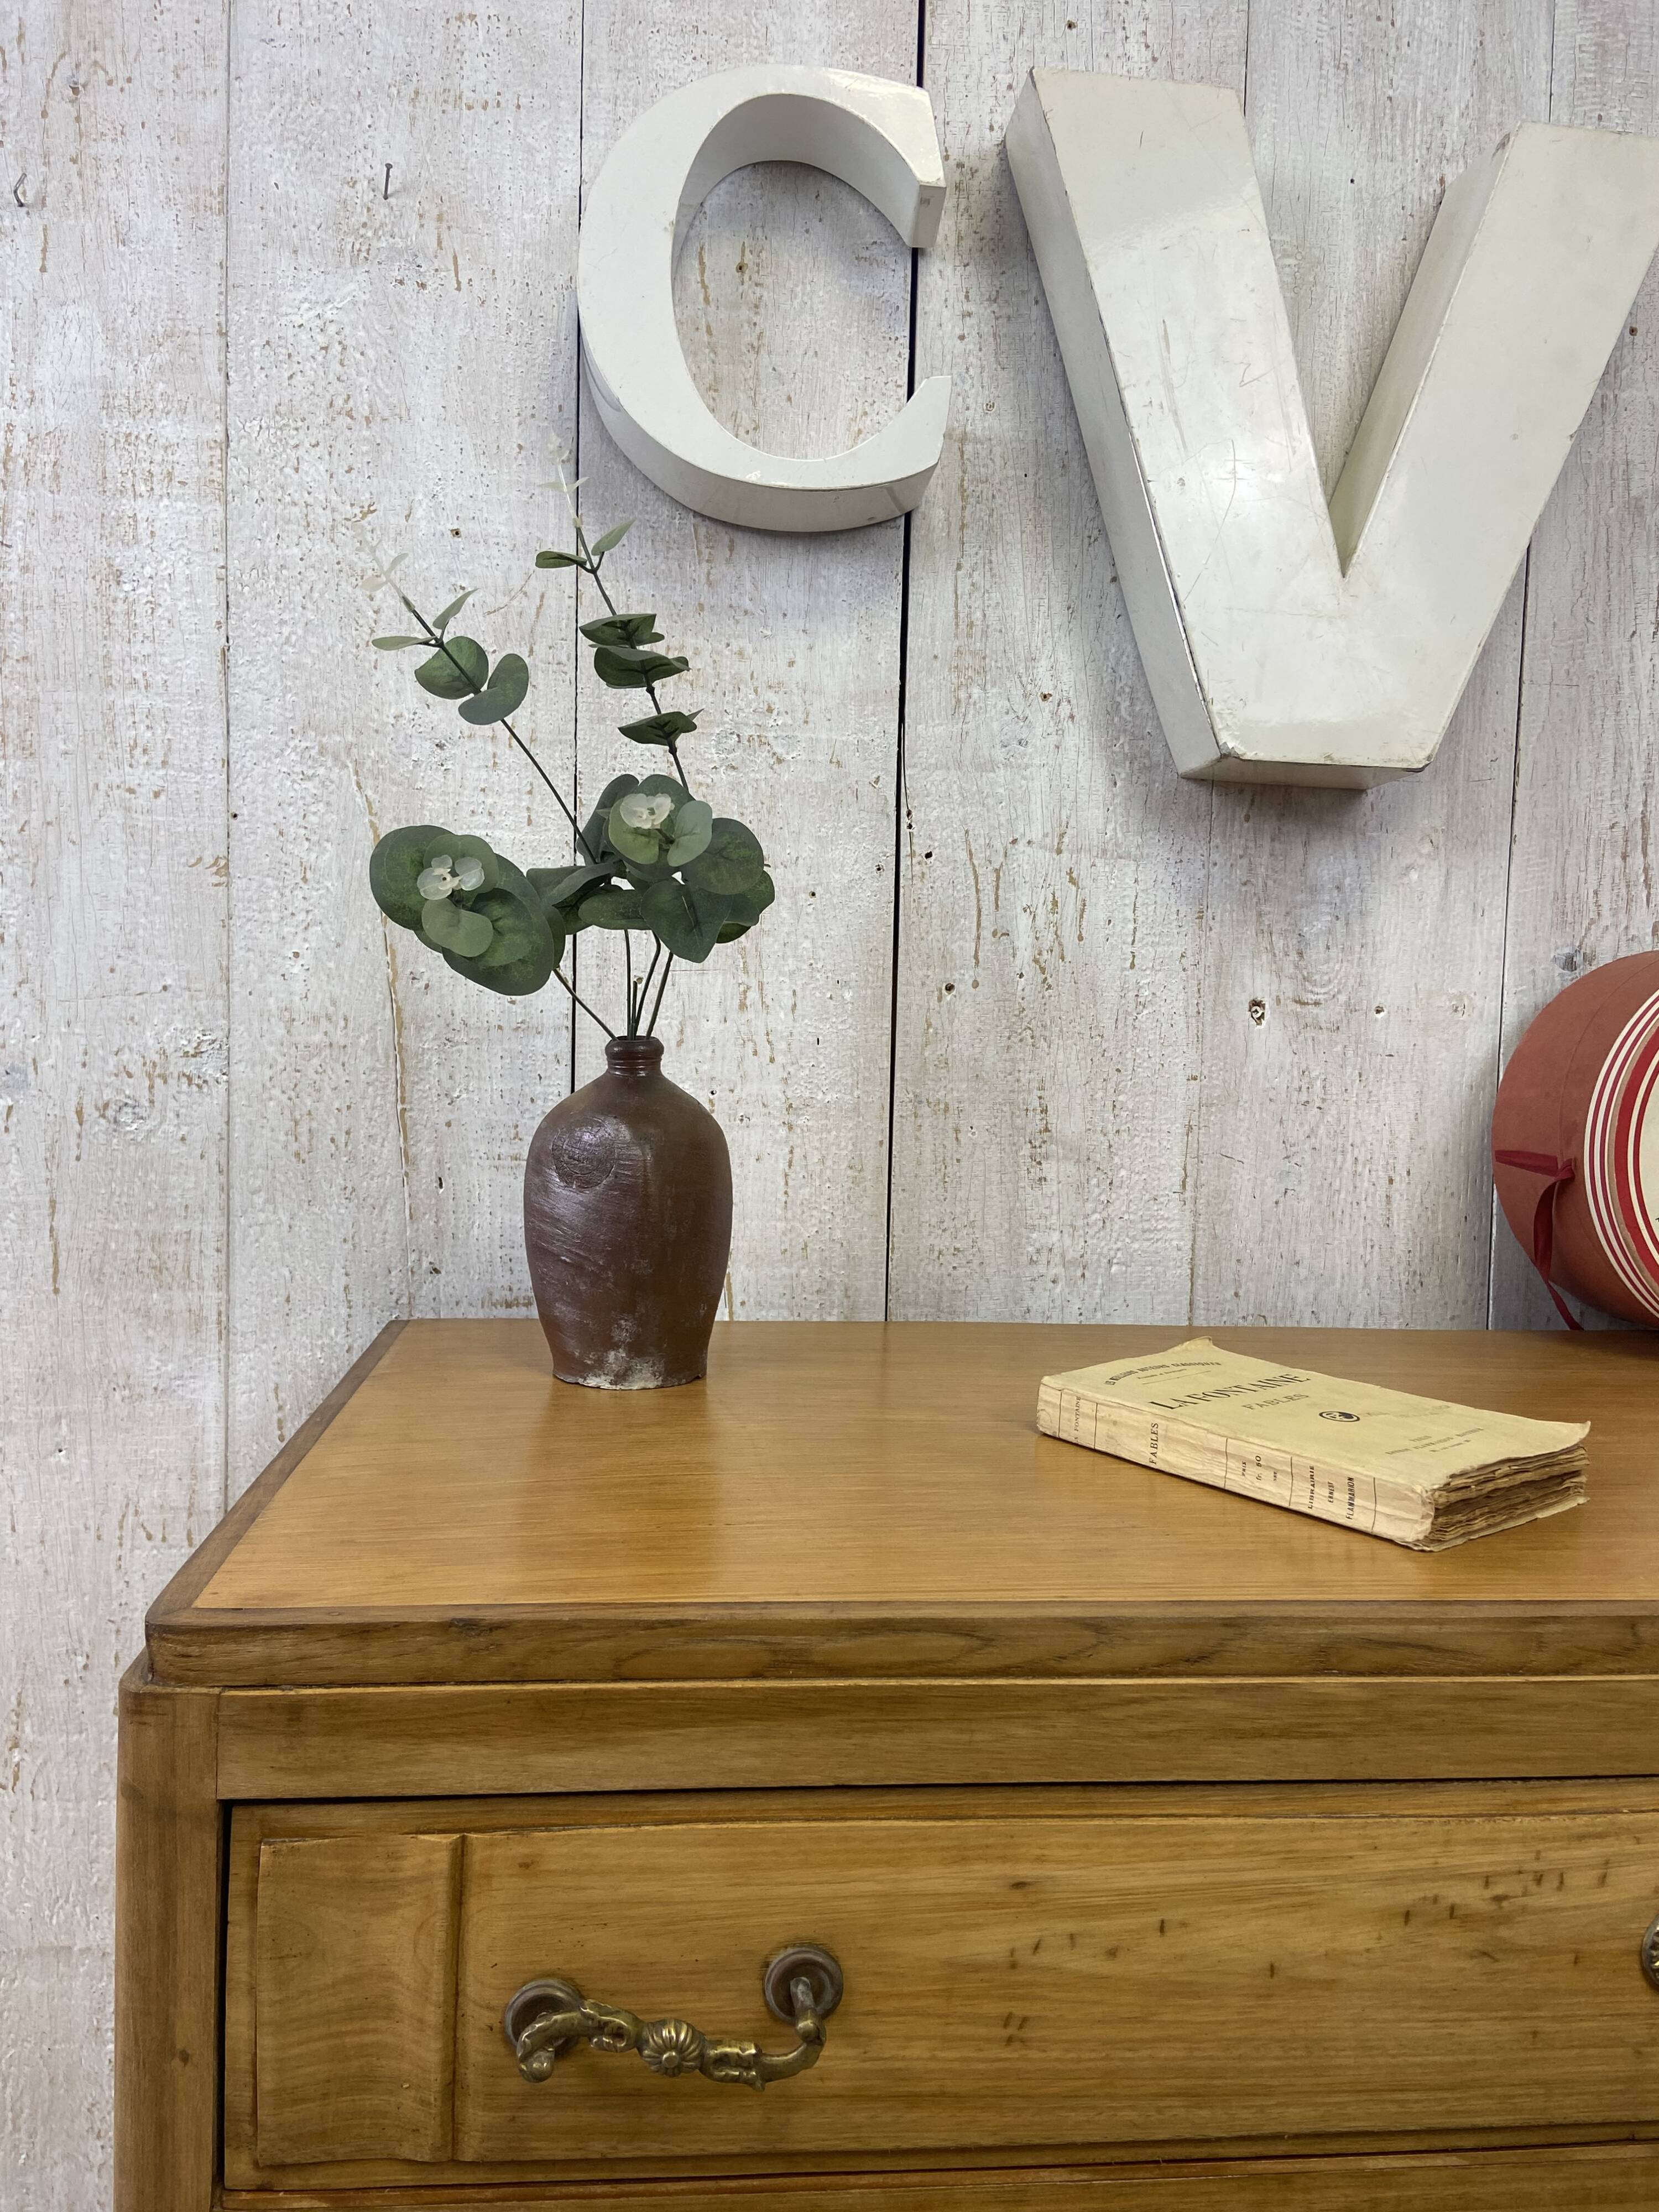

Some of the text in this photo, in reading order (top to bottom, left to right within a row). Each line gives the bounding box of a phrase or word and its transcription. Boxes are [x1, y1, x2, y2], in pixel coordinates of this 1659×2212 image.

[1148, 1397, 1199, 1410] LA
[1185, 1374, 1311, 1402] FONTAINE
[1241, 1393, 1310, 1410] FABLES
[1149, 1422, 1159, 1465] FABLES
[1345, 1477, 1355, 1520] FLAMMARION
